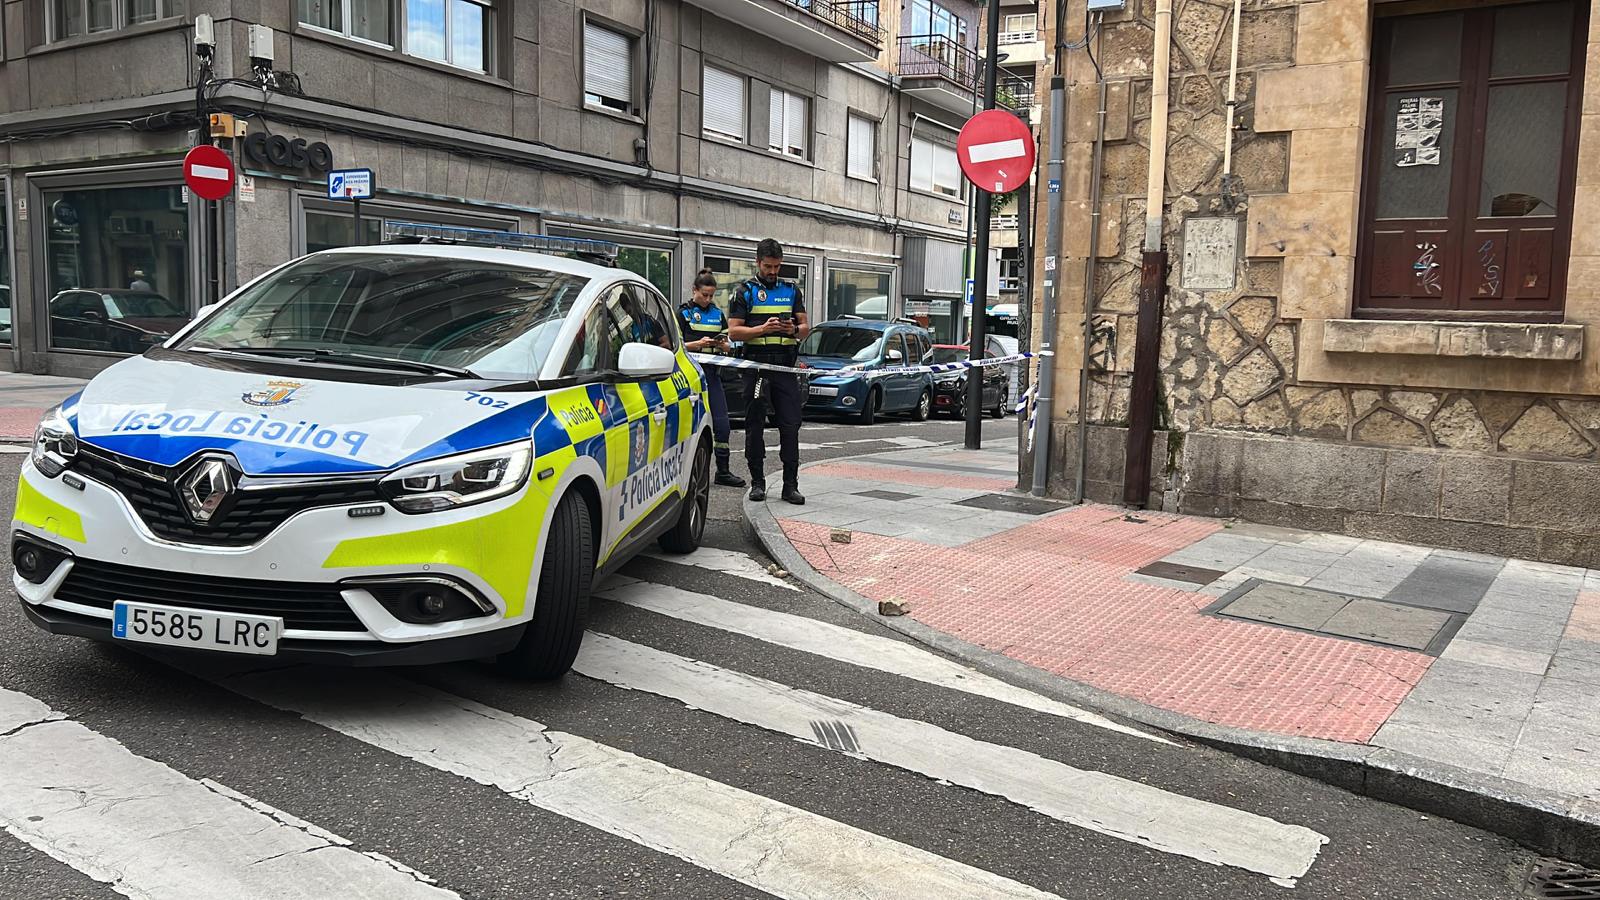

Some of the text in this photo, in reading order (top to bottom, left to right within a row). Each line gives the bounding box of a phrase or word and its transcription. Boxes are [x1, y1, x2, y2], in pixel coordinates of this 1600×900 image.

[463, 391, 509, 409] 702
[559, 402, 595, 428] Policía
[631, 448, 678, 509] Policía Local
[117, 608, 270, 648] E 5585 LRC
